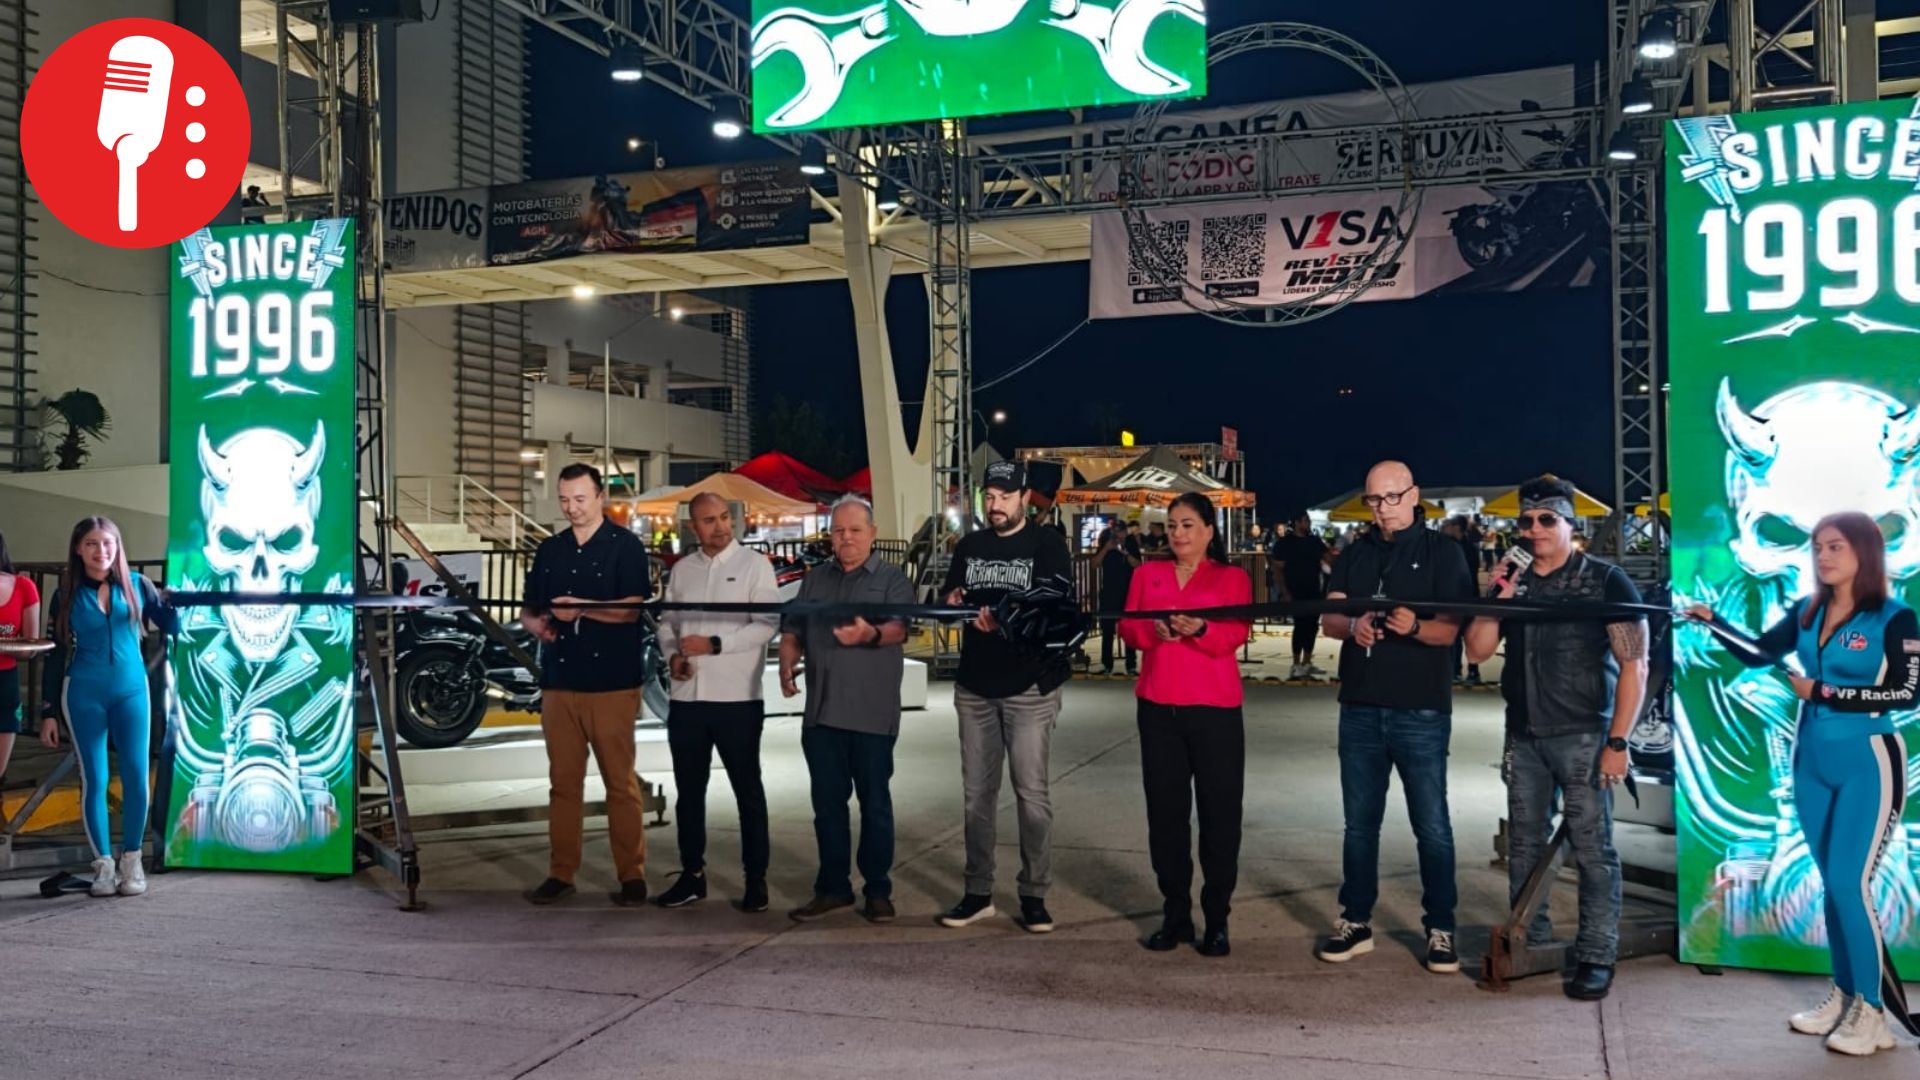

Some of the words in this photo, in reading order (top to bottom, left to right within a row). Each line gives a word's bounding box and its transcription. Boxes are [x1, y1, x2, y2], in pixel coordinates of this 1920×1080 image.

[1166, 152, 1279, 183] CÓDIG
[1721, 117, 1920, 193] SINCE
[493, 216, 514, 226] CON
[204, 233, 321, 287] SINCE
[189, 290, 335, 378] 1996
[1836, 689, 1857, 700] VP
[1860, 688, 1914, 701] Racing
